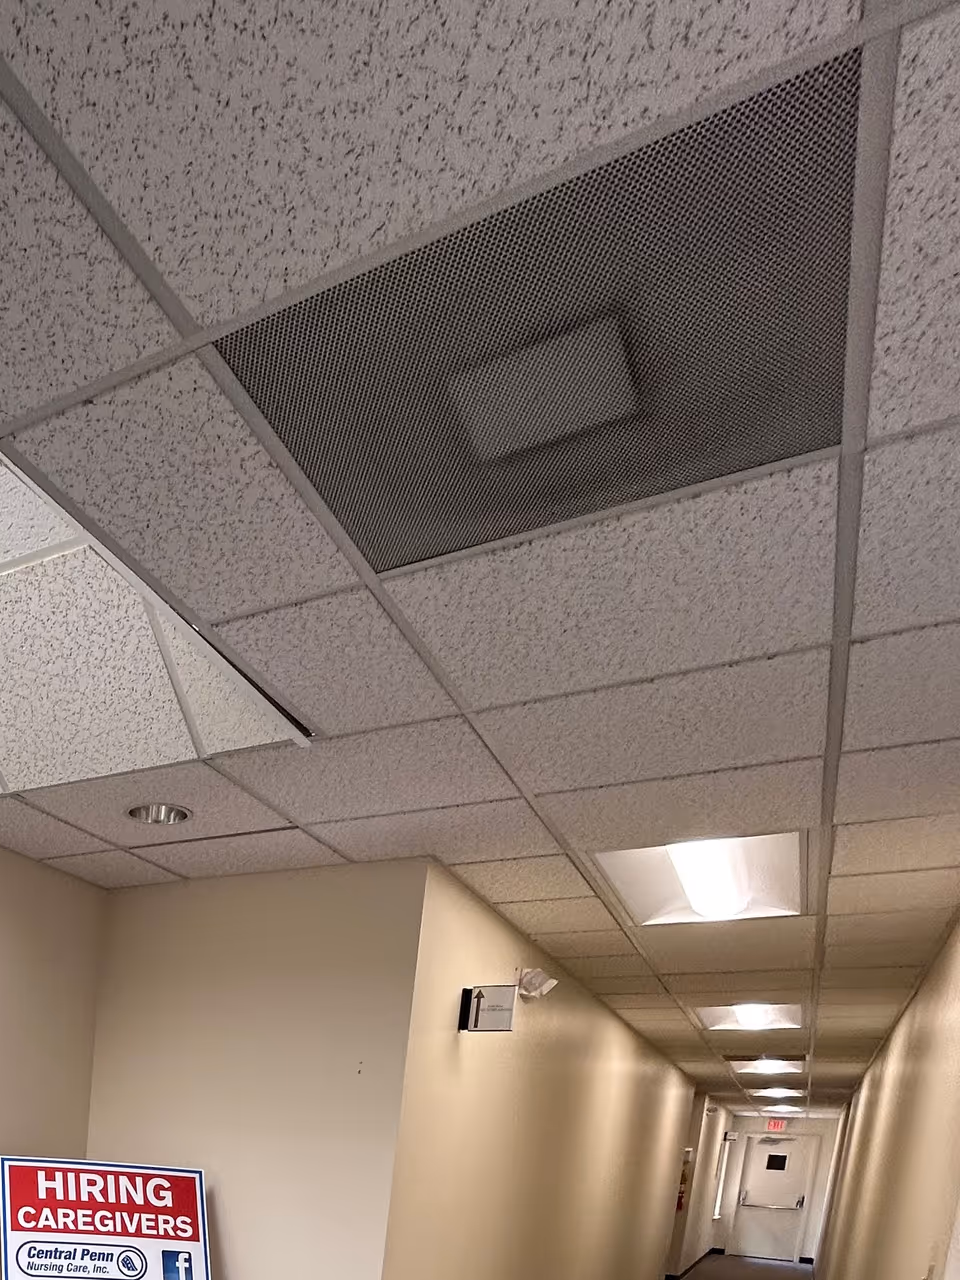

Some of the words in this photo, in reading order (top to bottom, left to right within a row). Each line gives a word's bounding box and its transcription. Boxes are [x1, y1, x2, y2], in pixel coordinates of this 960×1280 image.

[36, 1170, 173, 1207] HIRING
[17, 1206, 193, 1238] CAREGIVERS
[27, 1246, 76, 1260] Central
[80, 1248, 114, 1262] Penn
[26, 1261, 64, 1274] Nursing
[66, 1262, 91, 1274] Care,
[93, 1264, 110, 1274] Inc.
